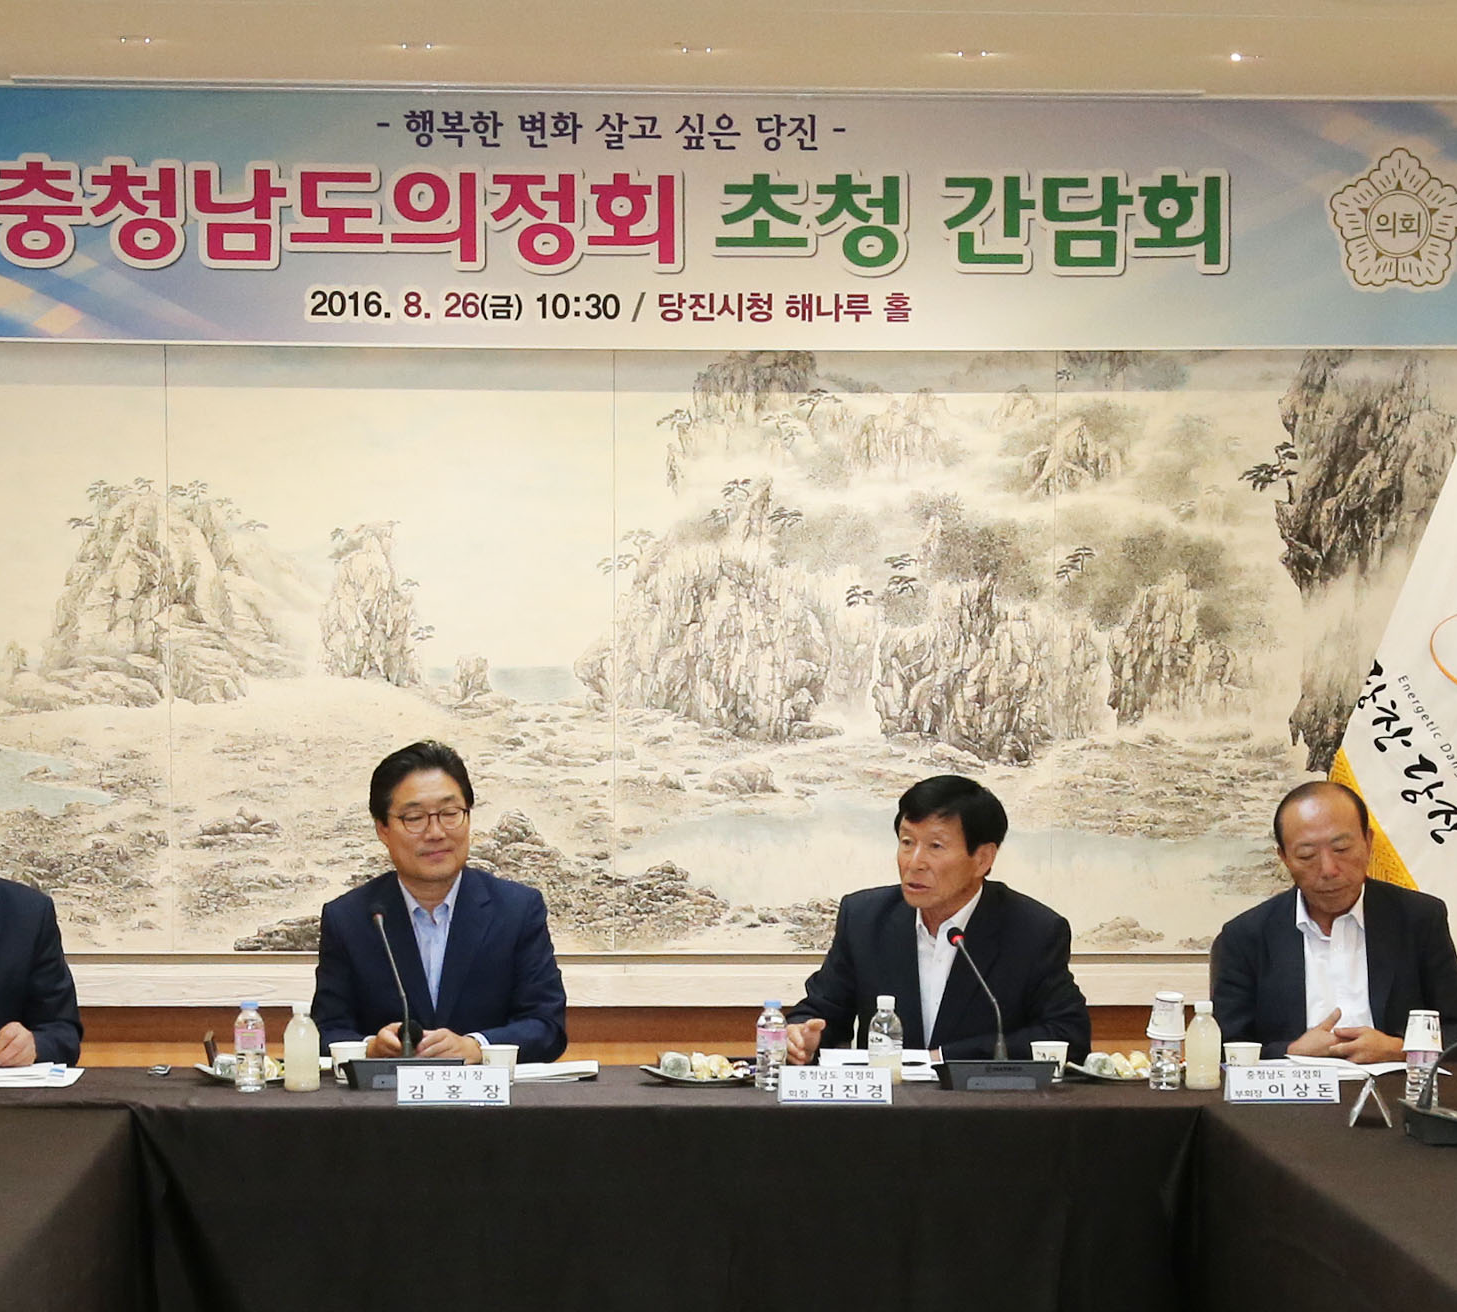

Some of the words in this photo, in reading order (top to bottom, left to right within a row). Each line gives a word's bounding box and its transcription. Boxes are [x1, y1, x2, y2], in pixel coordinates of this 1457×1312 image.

[404, 109, 504, 148] 행복한
[518, 111, 583, 147] 변화
[595, 112, 662, 150] 살고
[675, 113, 741, 151] 싶은
[756, 114, 819, 151] 당진
[715, 173, 899, 267] 초청
[943, 174, 1222, 265] 간담회
[1375, 212, 1421, 238] 의회
[310, 291, 391, 319] 2016.
[404, 291, 431, 319] 8.
[444, 292, 523, 321] 26(금)
[536, 292, 621, 319] 10:30
[658, 292, 774, 323] 당진시청
[785, 293, 872, 323] 해나루
[883, 293, 913, 323] 홀
[1398, 675, 1442, 738] Energetic
[799, 1070, 838, 1080] 충청남도
[845, 1070, 874, 1080] 의정회
[1246, 1070, 1286, 1079] 충청남도
[1292, 1070, 1321, 1079] 의정회
